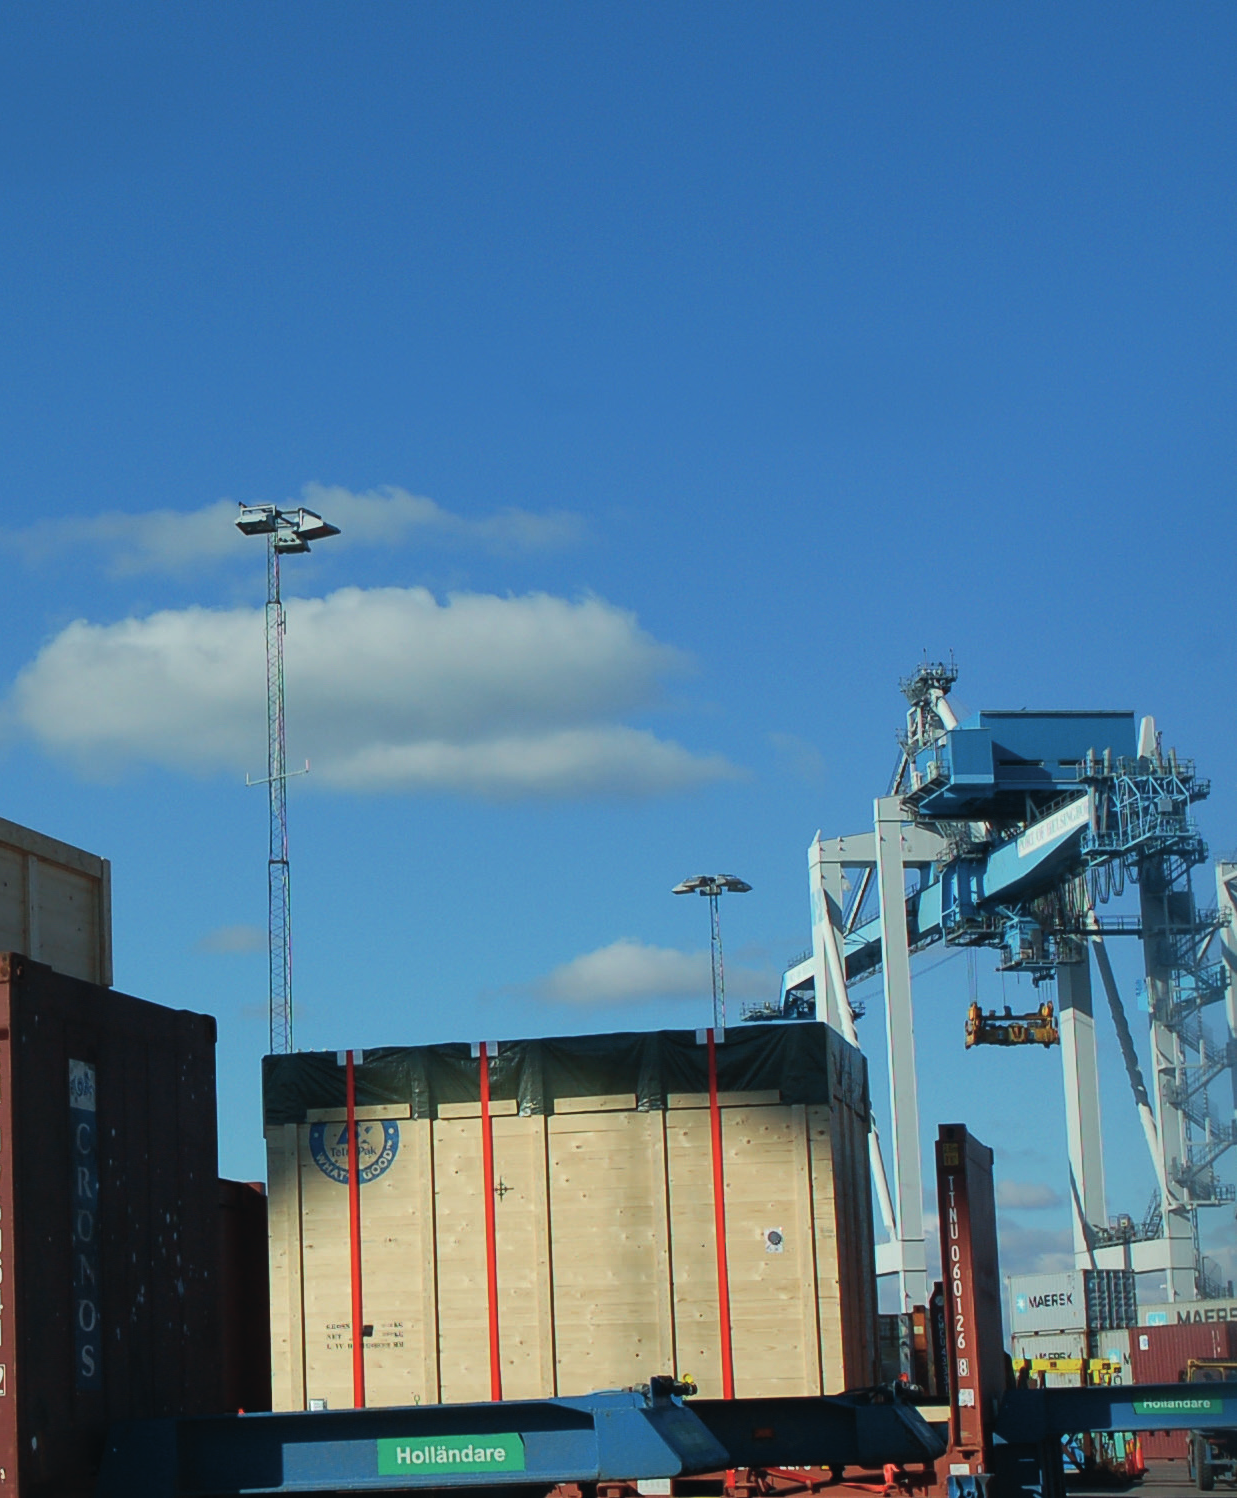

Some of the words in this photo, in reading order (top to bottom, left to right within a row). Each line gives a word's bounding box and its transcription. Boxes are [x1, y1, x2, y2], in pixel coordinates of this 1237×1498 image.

[331, 1147, 348, 1157] Tet
[948, 1176, 959, 1239] TTNU
[76, 1123, 96, 1377] CRONOS
[951, 1245, 966, 1349] 060126
[1028, 1292, 1073, 1308] MAERSK
[1176, 1306, 1237, 1325] MAERS
[958, 1359, 968, 1376] 8
[396, 1444, 506, 1465] Holländare
